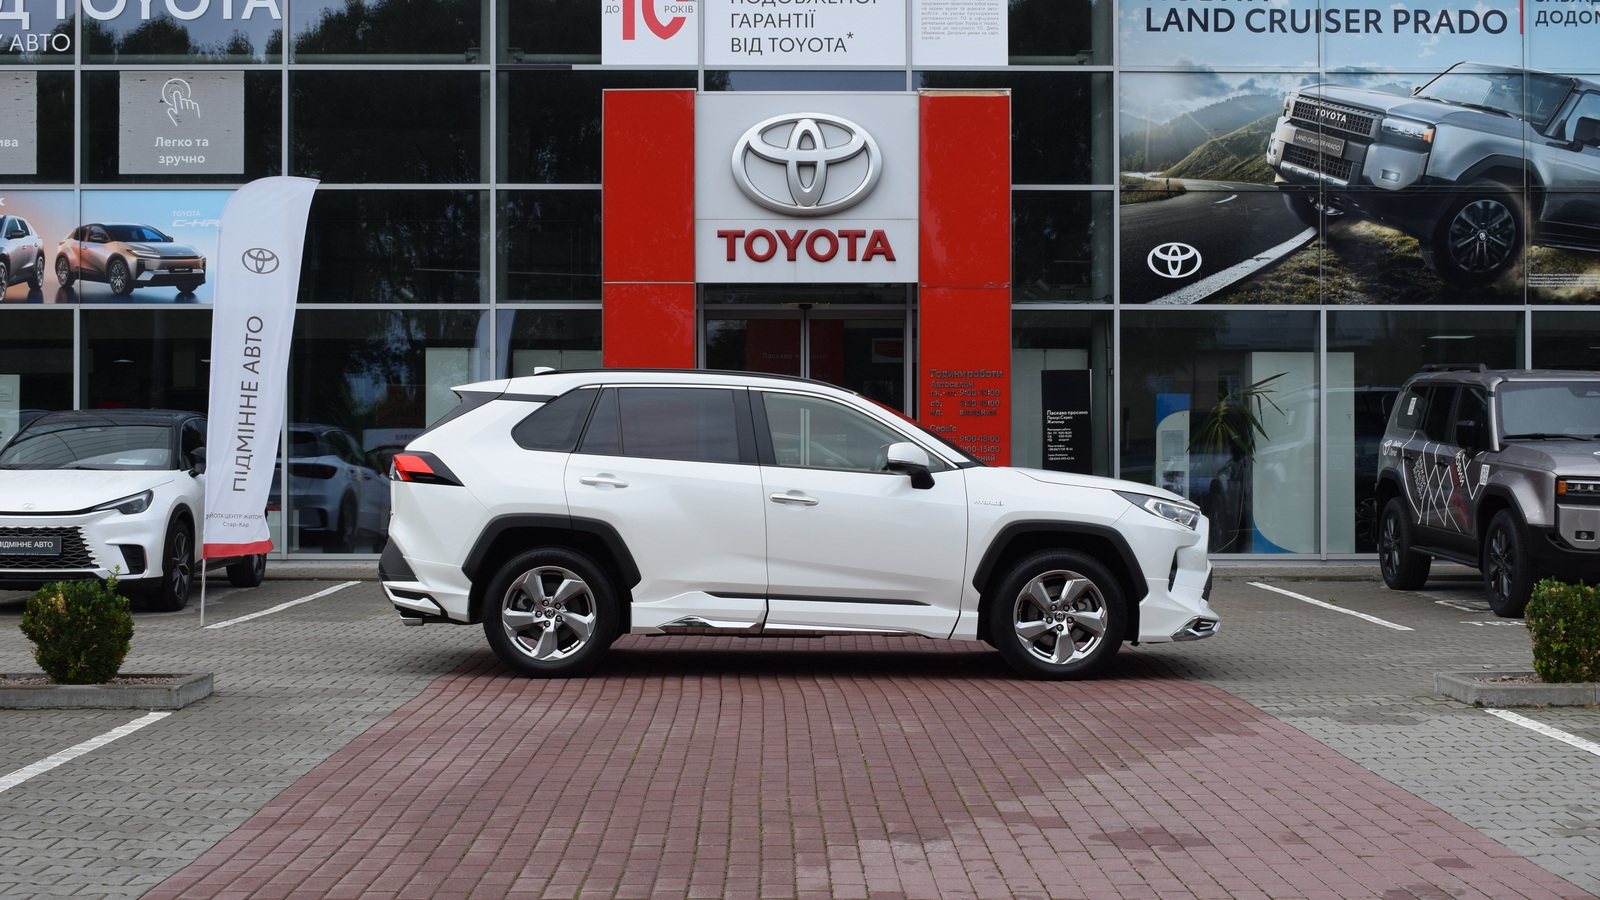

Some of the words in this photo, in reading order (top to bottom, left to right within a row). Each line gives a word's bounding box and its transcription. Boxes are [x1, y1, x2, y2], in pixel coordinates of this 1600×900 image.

[604, 6, 620, 14] ДО
[664, 6, 694, 14] РОКІВ
[1535, 10, 1600, 27] ДОДО
[730, 10, 814, 28] ГАРАНТІЇ
[1146, 8, 1235, 32] LAND
[1246, 8, 1383, 34] CRUISER
[1394, 8, 1508, 34] PRADO
[9, 33, 70, 52] АВТО
[731, 38, 763, 56] ВІД
[1314, 108, 1347, 122] TOYOTA
[154, 136, 193, 148] Легко
[196, 138, 209, 148] та
[158, 154, 206, 166] зручно
[717, 229, 896, 262] TOYOTA
[242, 316, 264, 375] АВТО
[930, 369, 965, 378] Години
[967, 369, 1002, 379] роботи
[232, 380, 259, 492] ПІДМІННЕ
[930, 424, 957, 433] Сервіс
